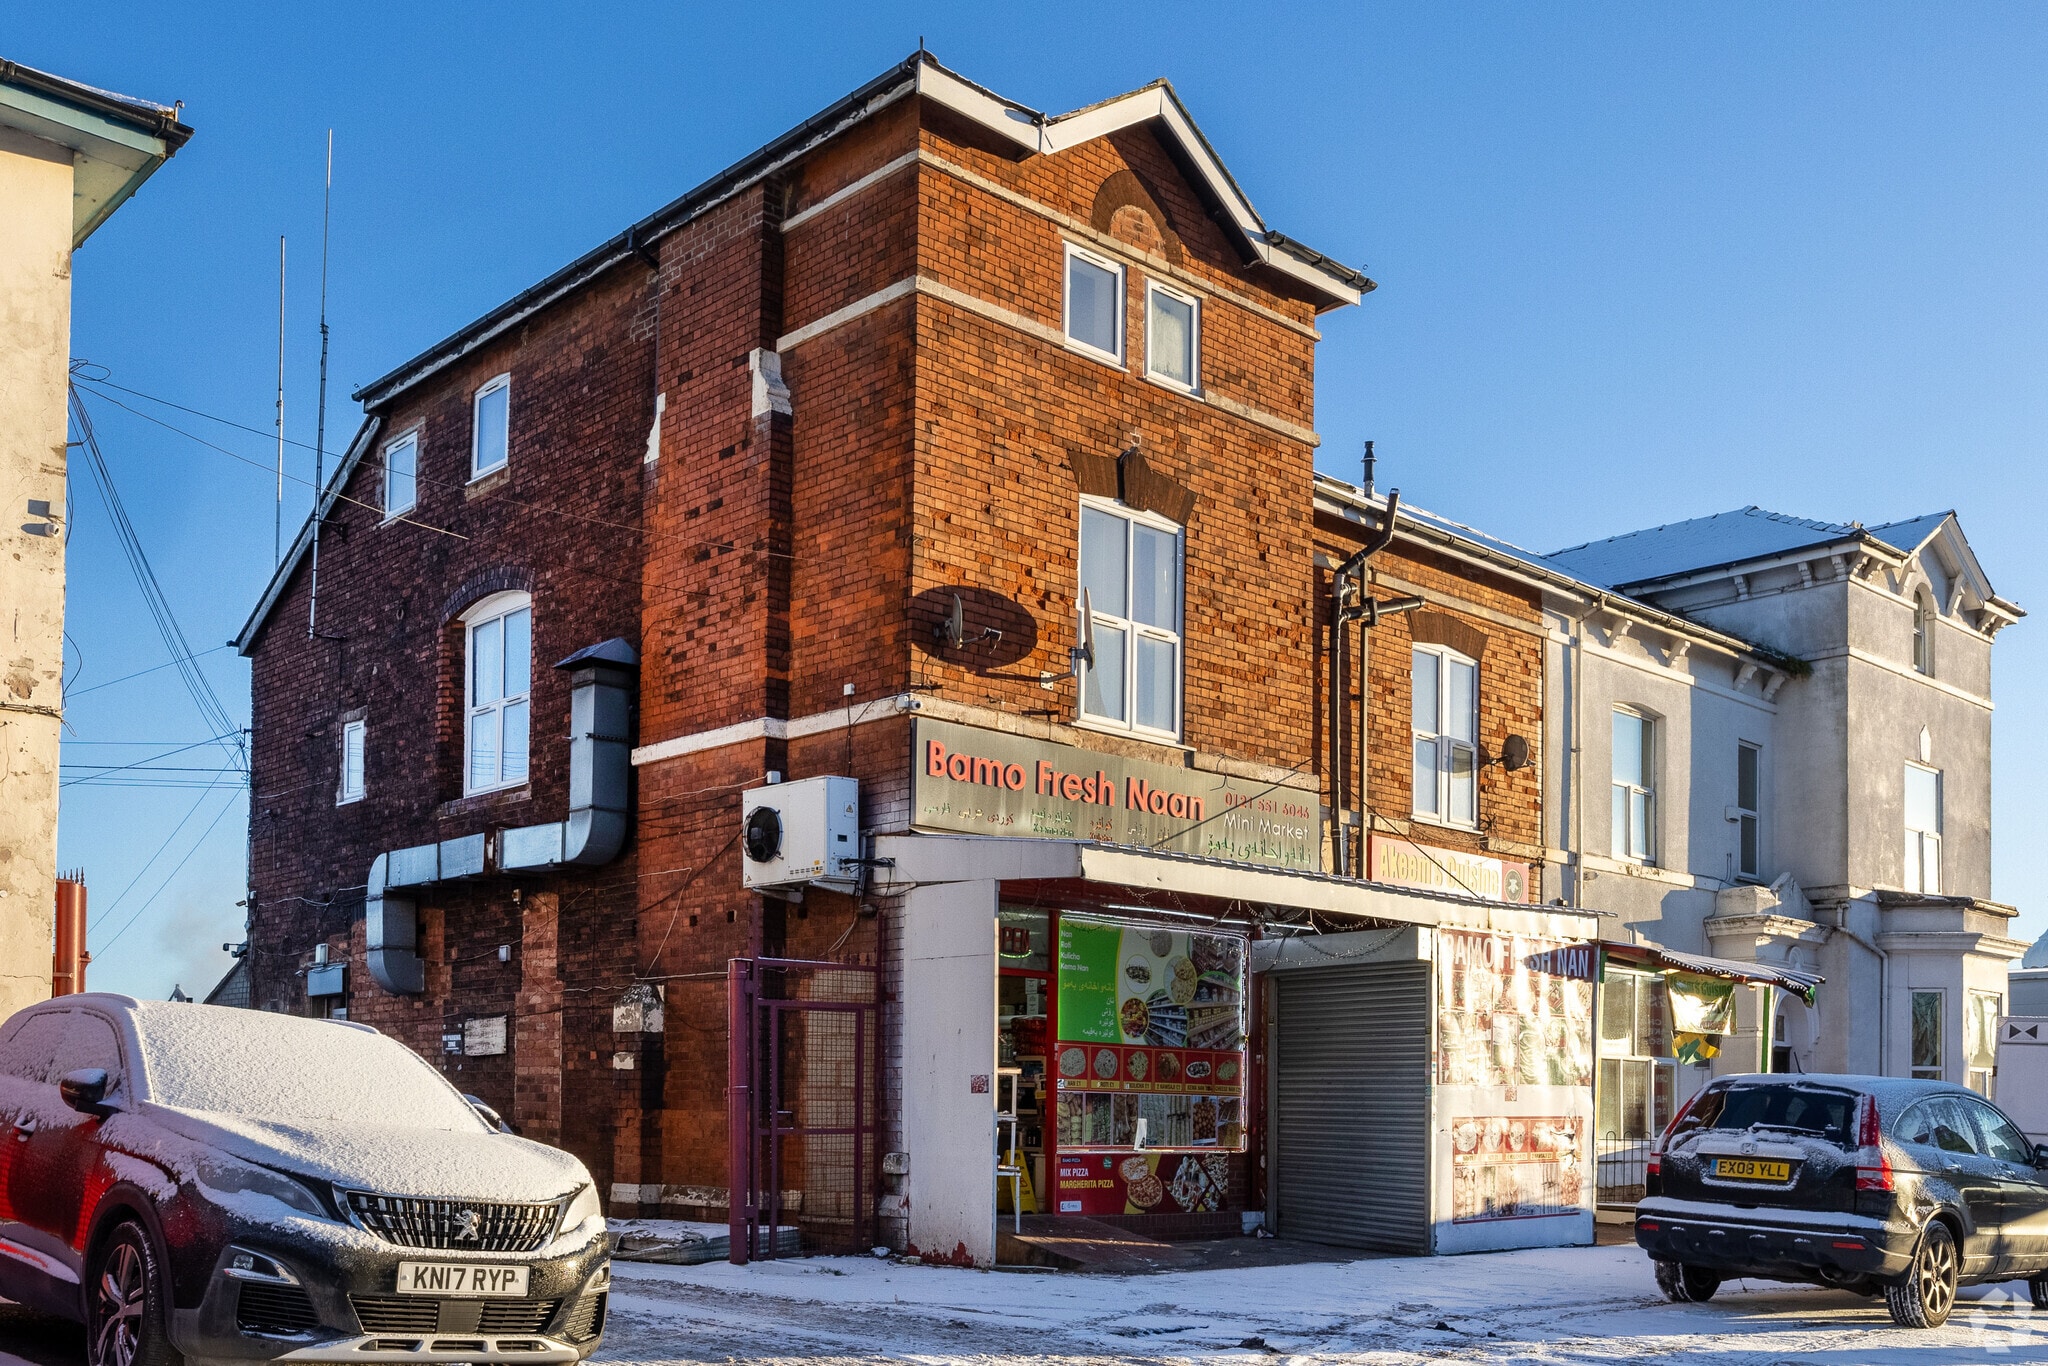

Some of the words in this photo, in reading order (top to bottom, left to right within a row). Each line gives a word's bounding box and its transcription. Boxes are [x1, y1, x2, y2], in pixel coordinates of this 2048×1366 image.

[926, 739, 1026, 791] Bamo
[1036, 760, 1115, 807] Fresh
[1126, 777, 1204, 821] Naan
[1225, 792, 1252, 809] 0121
[1258, 799, 1277, 813] 551
[1224, 812, 1254, 832] Mini
[1259, 818, 1309, 840] Market
[1379, 844, 1443, 887] Akeem's
[1446, 855, 1499, 896] Cuisine
[999, 926, 1030, 953] PEN
[1061, 930, 1072, 938] Nan
[1556, 947, 1589, 977] NAN
[1060, 1168, 1071, 1177] MIX
[1072, 1168, 1089, 1177] PIZZA
[1719, 1161, 1755, 1174] EX08
[1760, 1164, 1785, 1177] YLL
[1060, 1180, 1097, 1188] MARGHERITA
[1098, 1180, 1114, 1188] PIZZA
[413, 1266, 466, 1290] KN17
[472, 1268, 516, 1291] RYP
